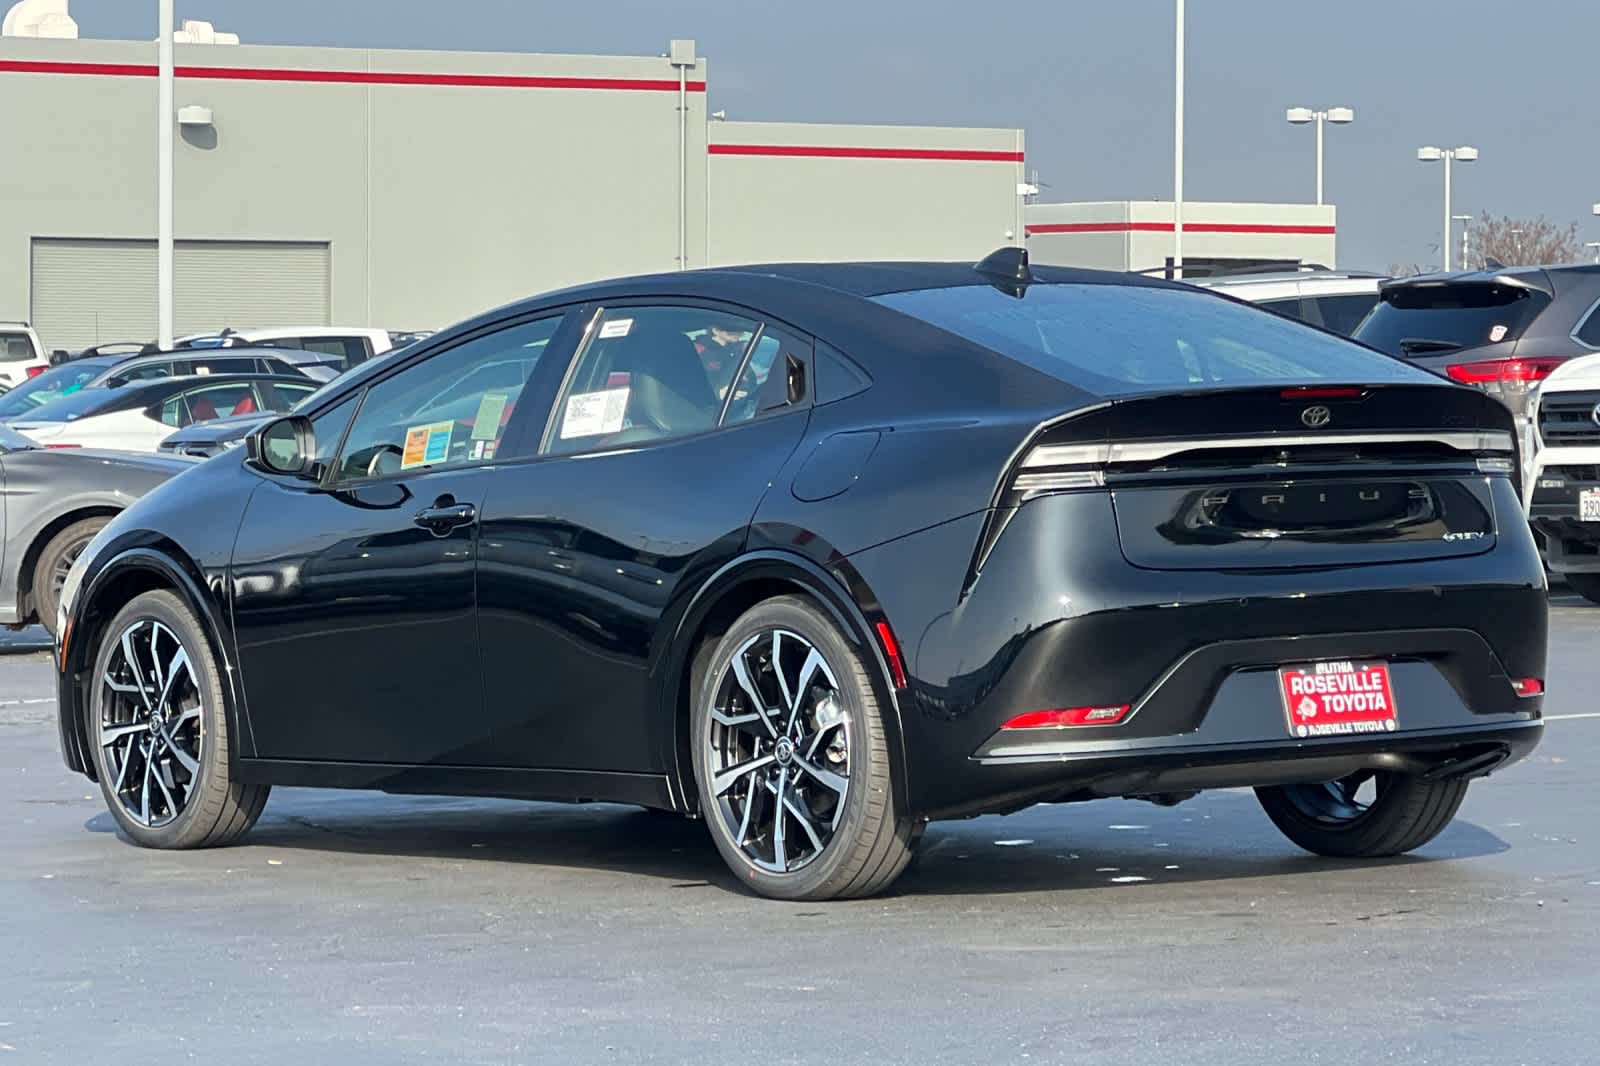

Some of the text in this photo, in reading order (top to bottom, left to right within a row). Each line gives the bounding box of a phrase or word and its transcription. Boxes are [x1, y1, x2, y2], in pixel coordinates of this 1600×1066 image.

[1291, 672, 1382, 695] ROSEVILLE
[1321, 692, 1387, 712] TOYOTA
[1308, 720, 1384, 735] ROSEVILLE TOYOTA
